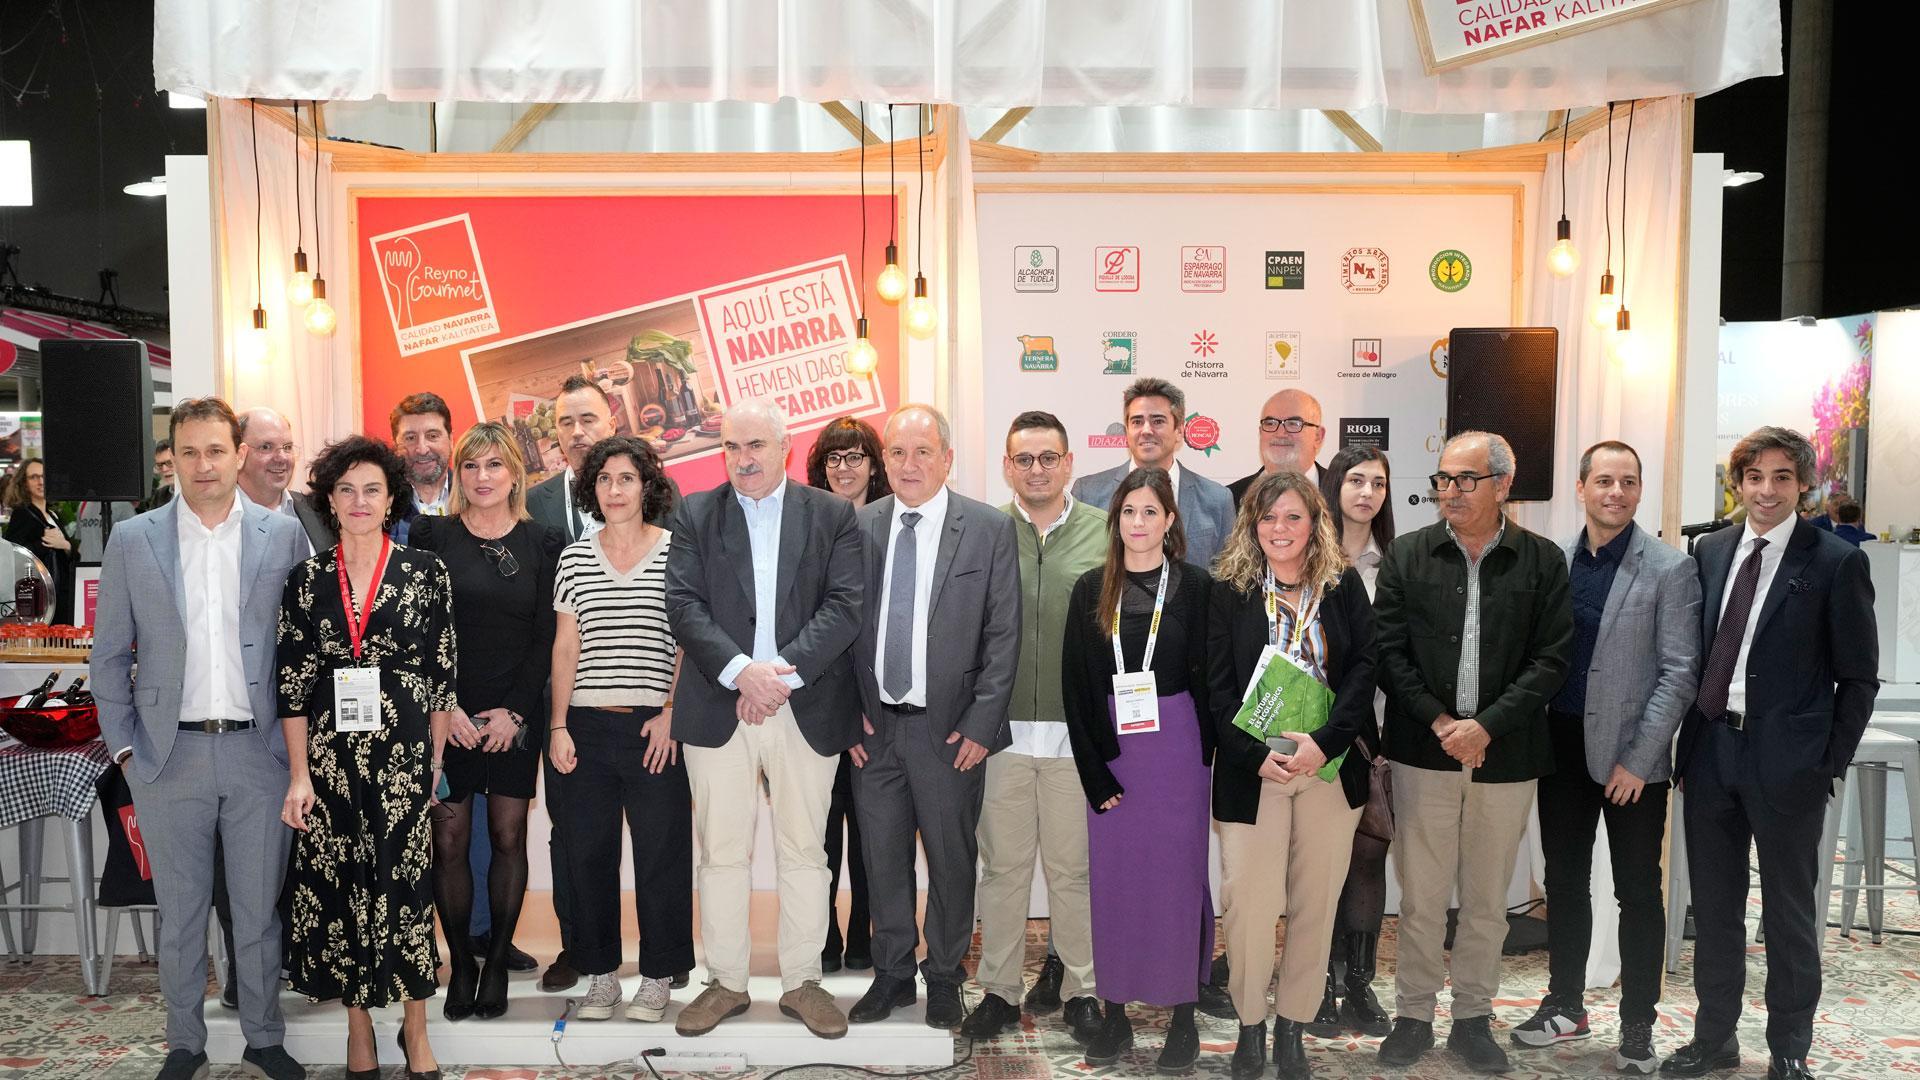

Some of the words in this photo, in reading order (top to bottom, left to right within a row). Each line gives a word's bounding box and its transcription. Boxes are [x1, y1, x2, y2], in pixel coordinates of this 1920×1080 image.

[1464, 10, 1547, 46] NAFAR
[1268, 256, 1303, 265] CPAEN
[1268, 266, 1303, 275] NNPEK
[411, 272, 483, 301] Gourmet
[424, 267, 467, 284] Reyno
[722, 287, 775, 332] AQUÍ
[779, 273, 836, 318] ESTÁ
[401, 325, 441, 341] CALIDAD
[443, 312, 491, 330] NAVARRA
[404, 337, 439, 351] NAFAR
[441, 322, 495, 341] KALITATEA
[726, 313, 847, 366] NAVARRA
[1181, 370, 1192, 378] de
[1194, 370, 1228, 378] Navarra
[1185, 360, 1225, 369] Chistorra
[1373, 371, 1397, 379] Milagro
[736, 361, 801, 399] HEMEN
[775, 379, 863, 418] FARROA
[1151, 611, 1160, 634] HOSTELCO
[1253, 692, 1271, 717] FUTURO
[1255, 720, 1263, 729] ES
